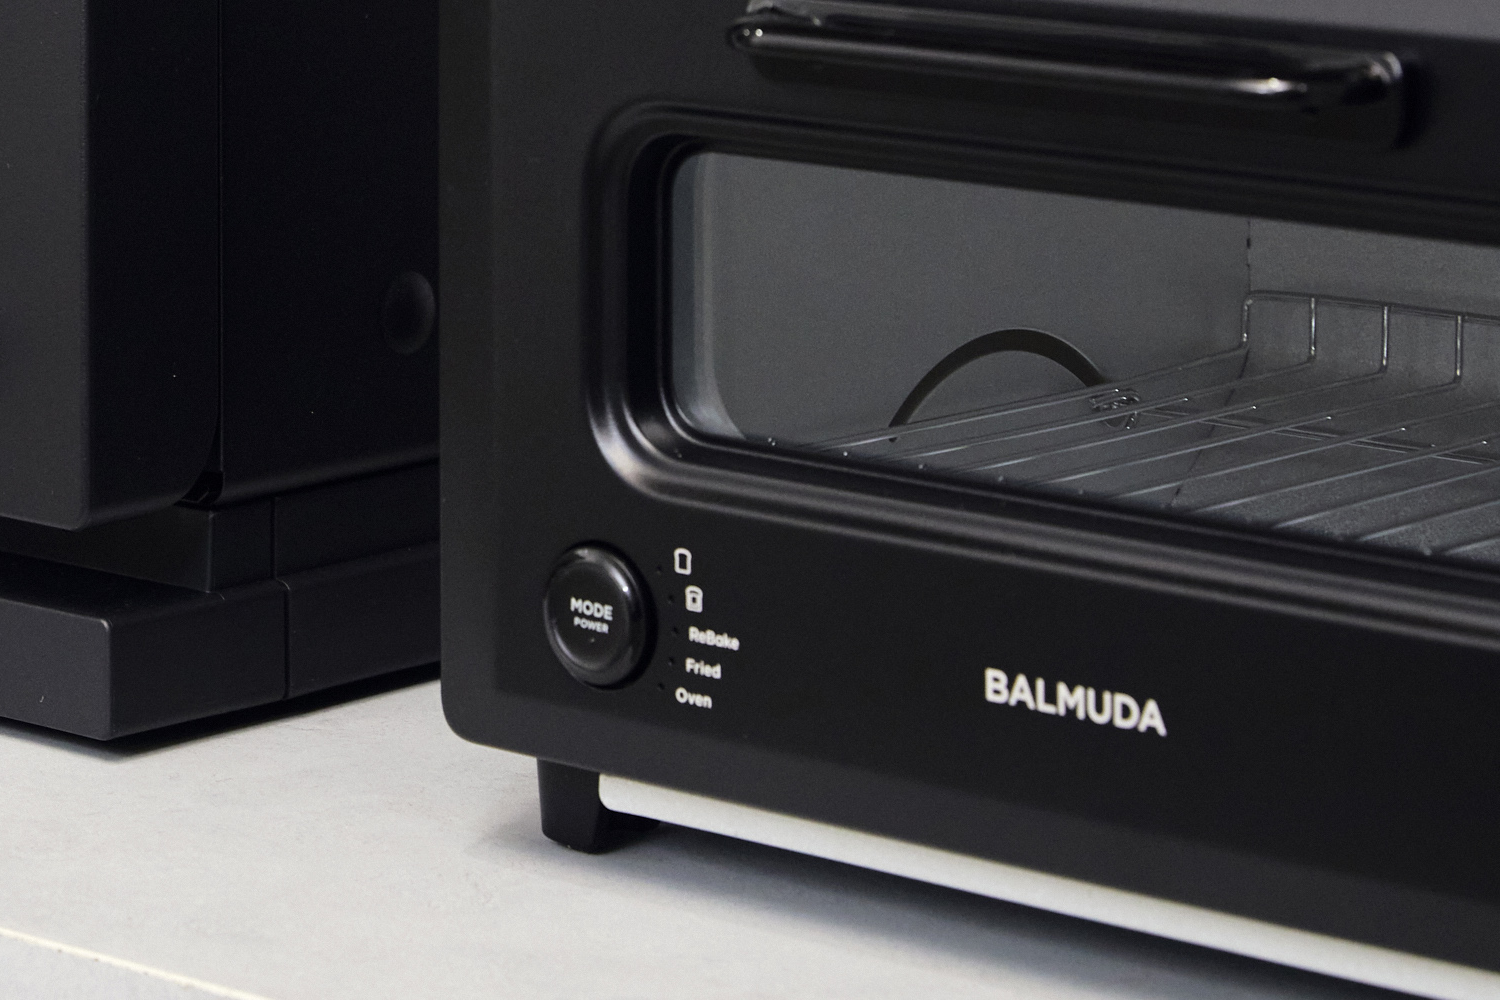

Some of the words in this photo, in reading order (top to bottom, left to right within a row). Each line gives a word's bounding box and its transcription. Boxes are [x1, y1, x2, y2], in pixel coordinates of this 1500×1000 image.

[570, 596, 614, 621] MODE
[573, 616, 610, 634] POWER
[688, 626, 740, 651] ReBake
[685, 657, 722, 680] Fried
[675, 687, 713, 709] Oven
[984, 667, 1168, 738] BALMUDA
